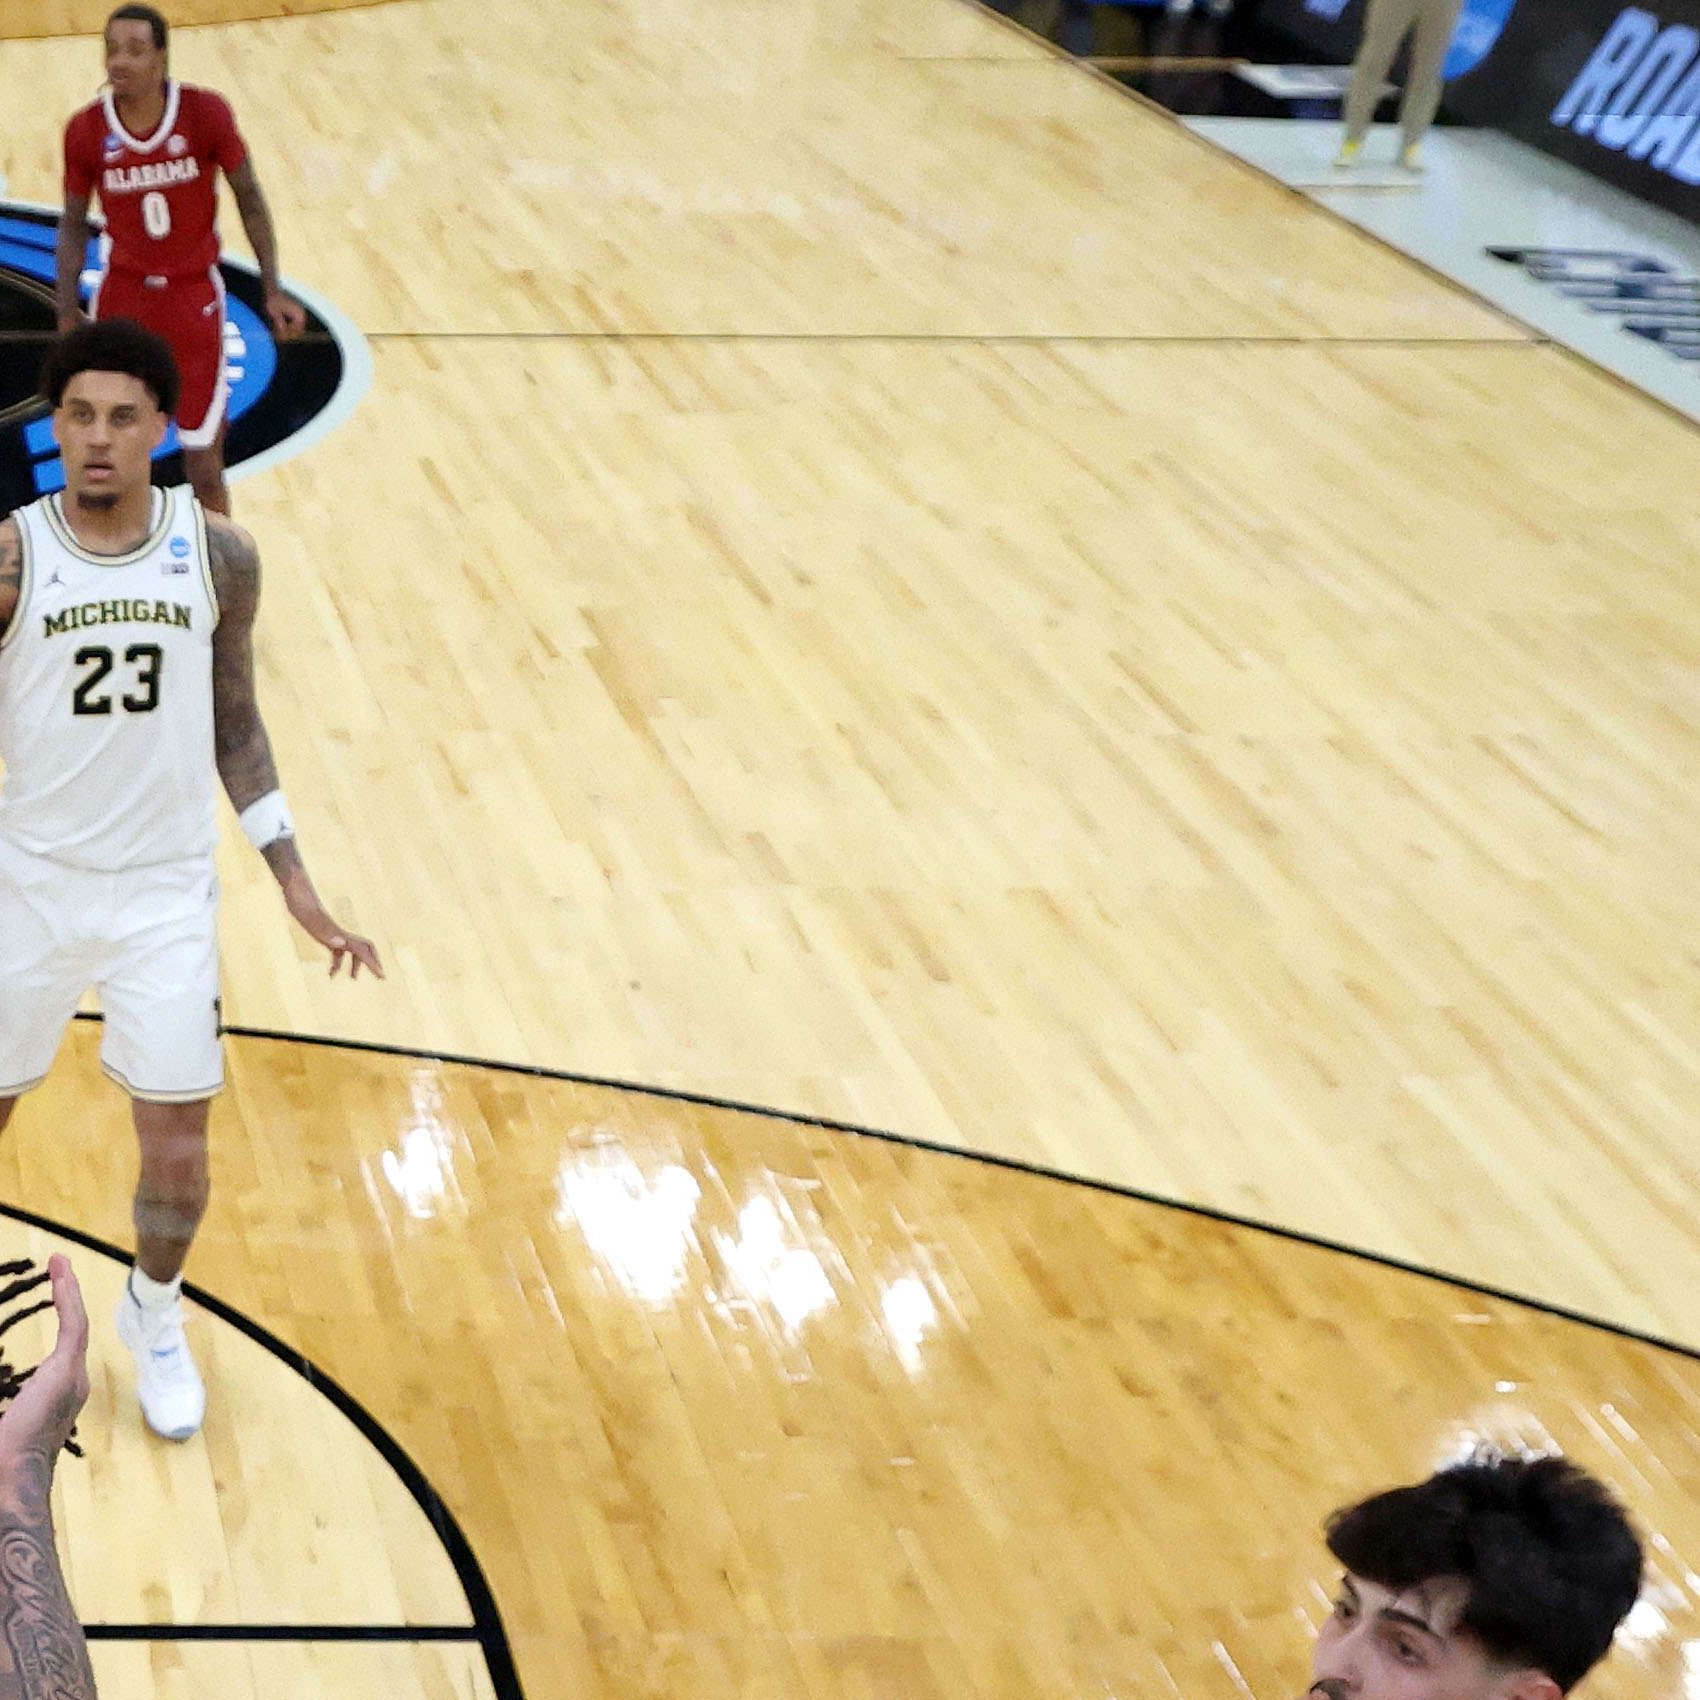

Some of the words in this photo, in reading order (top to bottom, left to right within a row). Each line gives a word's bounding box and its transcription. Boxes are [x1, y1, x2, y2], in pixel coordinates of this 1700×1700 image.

[1548, 6, 1700, 186] ROA
[103, 156, 200, 193] ALABAMA
[141, 191, 172, 240] 0
[43, 599, 192, 639] MICHIGAN
[73, 643, 164, 715] 23
